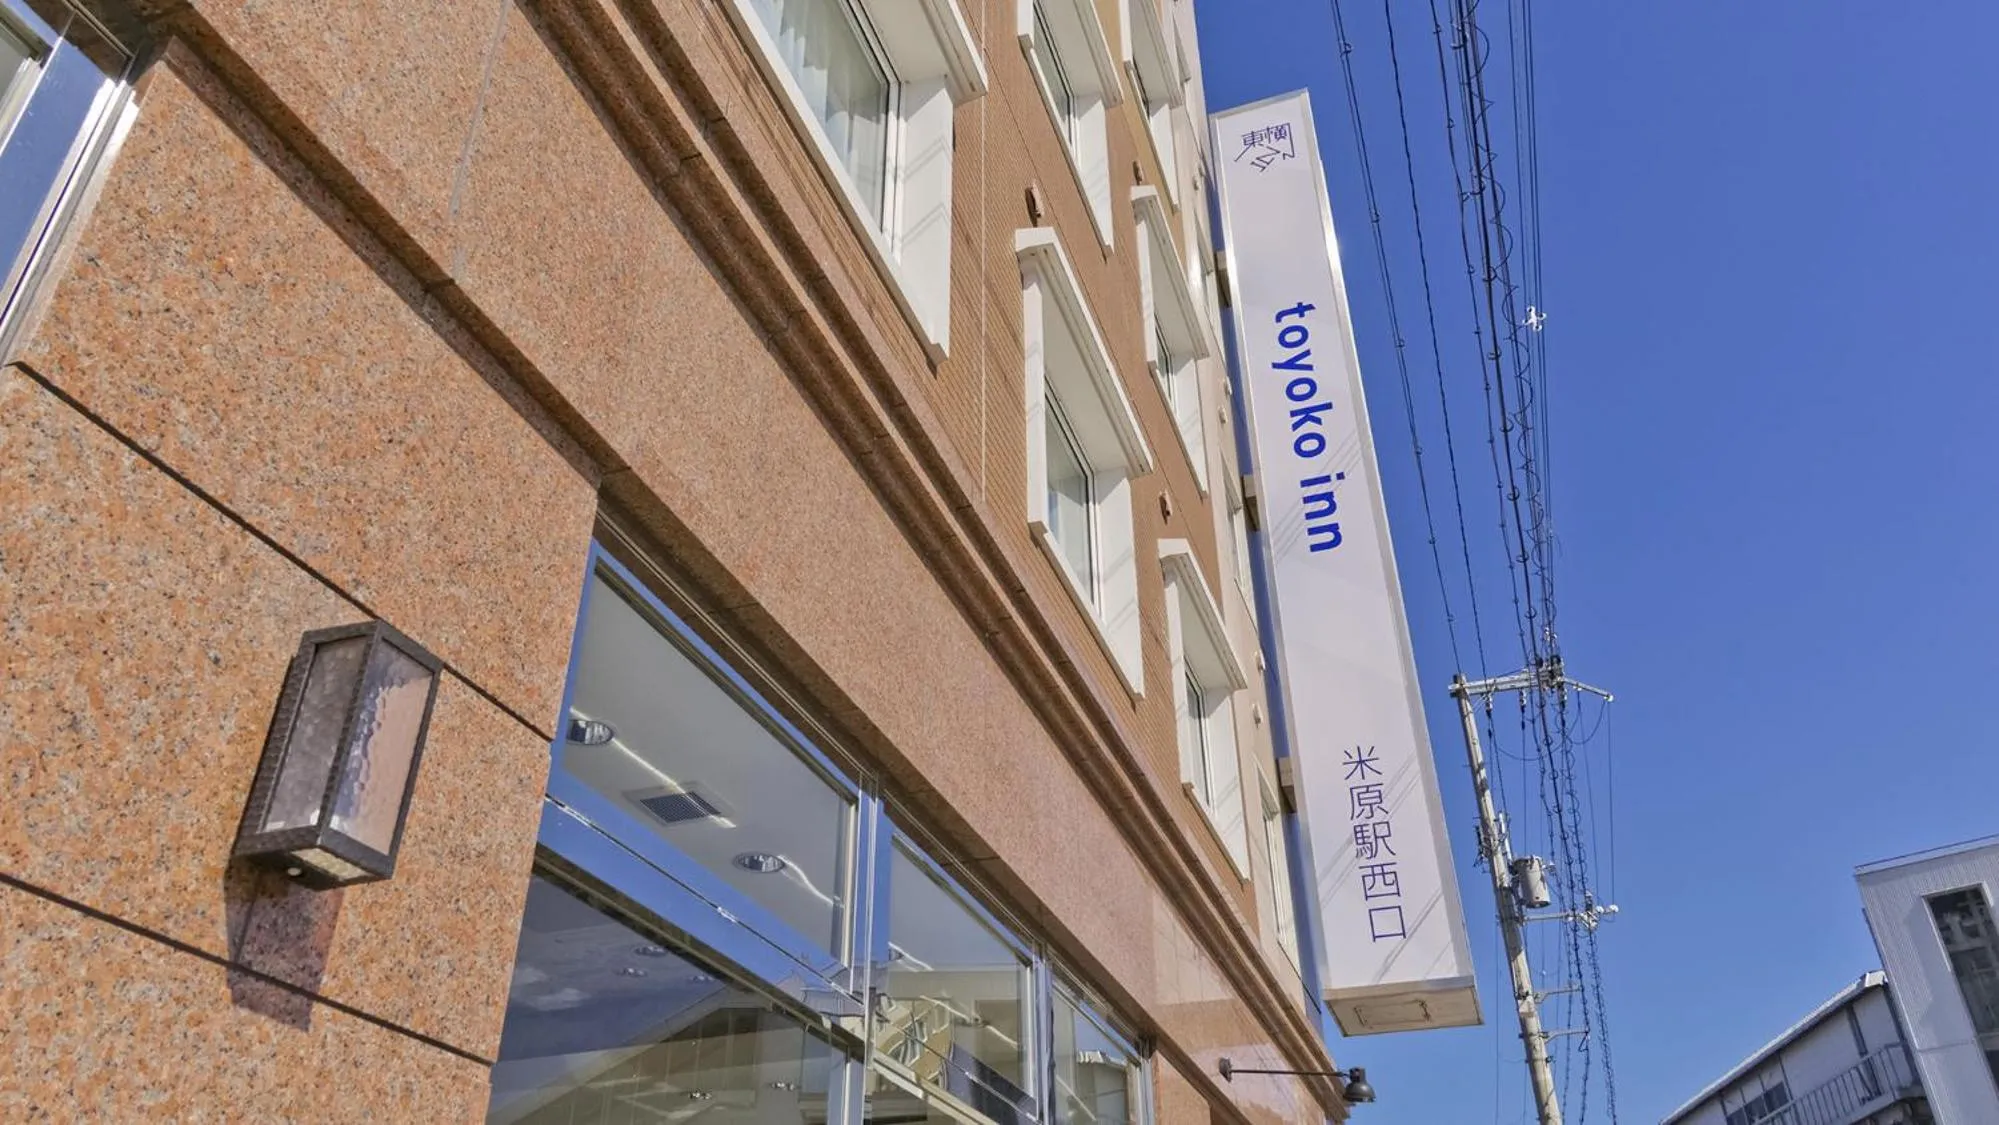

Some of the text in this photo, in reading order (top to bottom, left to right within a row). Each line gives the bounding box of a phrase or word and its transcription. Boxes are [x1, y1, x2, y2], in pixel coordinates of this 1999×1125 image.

[1271, 301, 1346, 553] toyoko inn
[1342, 745, 1407, 943] 米原駅西口
